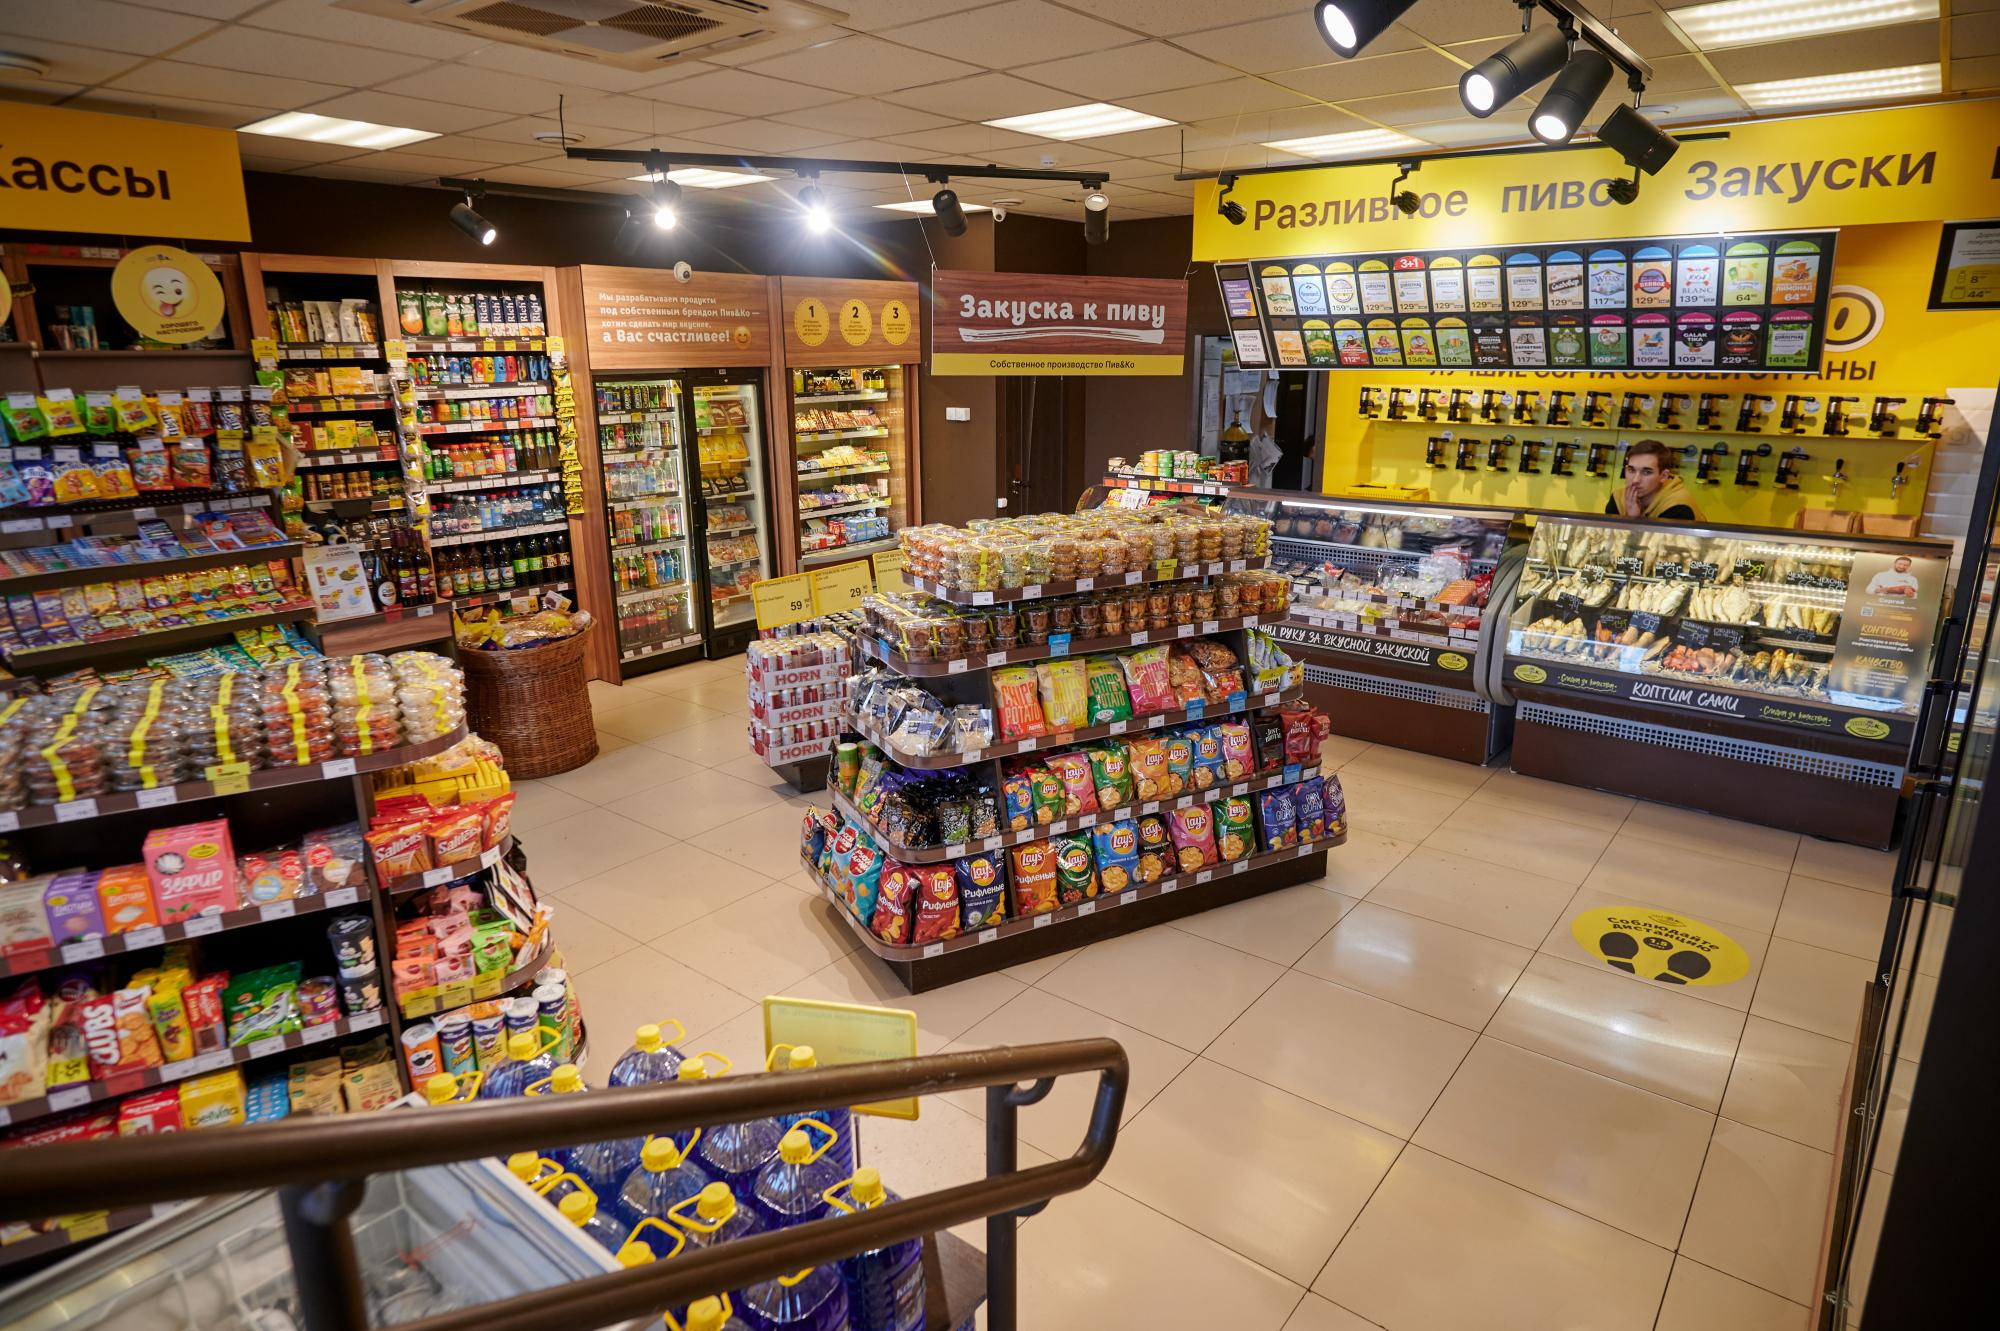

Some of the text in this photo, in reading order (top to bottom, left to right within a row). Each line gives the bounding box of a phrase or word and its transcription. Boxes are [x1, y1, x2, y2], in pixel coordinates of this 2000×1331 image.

[1684, 150, 1936, 204] Закуски
[1400, 258, 1420, 268] 3+1
[599, 292, 614, 302] Мы
[679, 296, 716, 305] продукты
[479, 303, 489, 323] Rich
[493, 304, 502, 323] Rich
[505, 303, 515, 323] Rich
[518, 303, 528, 323] Rich
[532, 303, 542, 323] Rich
[600, 306, 618, 316] под
[620, 306, 680, 317] собственным
[682, 306, 719, 318] брендом
[808, 305, 815, 318] 1
[852, 306, 859, 318] 2
[892, 307, 899, 319] 3
[959, 294, 1166, 328] Закуска к пиву
[601, 320, 627, 328] хотим
[628, 320, 660, 329] сделать
[662, 321, 677, 330] мир
[602, 329, 730, 343] а Вас счастливее!
[989, 359, 1135, 370] Собственное производство Пив&Ко
[1747, 565, 1762, 576] 29
[849, 587, 862, 598] 29
[790, 600, 802, 611] 59
[1860, 623, 1909, 637] КОНТРОЛЬ
[1279, 627, 1305, 642] РУКУ
[1309, 632, 1321, 643] ЗА
[1323, 633, 1371, 653] ВКУСНОЙ
[1374, 643, 1431, 662] ЗАКУСКОЙ
[1855, 655, 1904, 670] КАЧЕСТВО
[775, 668, 821, 687] HORN
[1089, 672, 1121, 697] CHIPS
[1000, 682, 1034, 708] CHIPS
[1632, 681, 1740, 711] КОПТИМ САМИ
[779, 704, 825, 723] HORN
[1003, 705, 1042, 725] POTATO
[780, 741, 824, 760] HORN
[1013, 870, 1056, 885] Рифленые
[964, 882, 1004, 899] Рифленые
[1607, 917, 1720, 950] Соблюдайте
[1612, 923, 1712, 952] дистанцию
[189, 1104, 238, 1126] belVita
